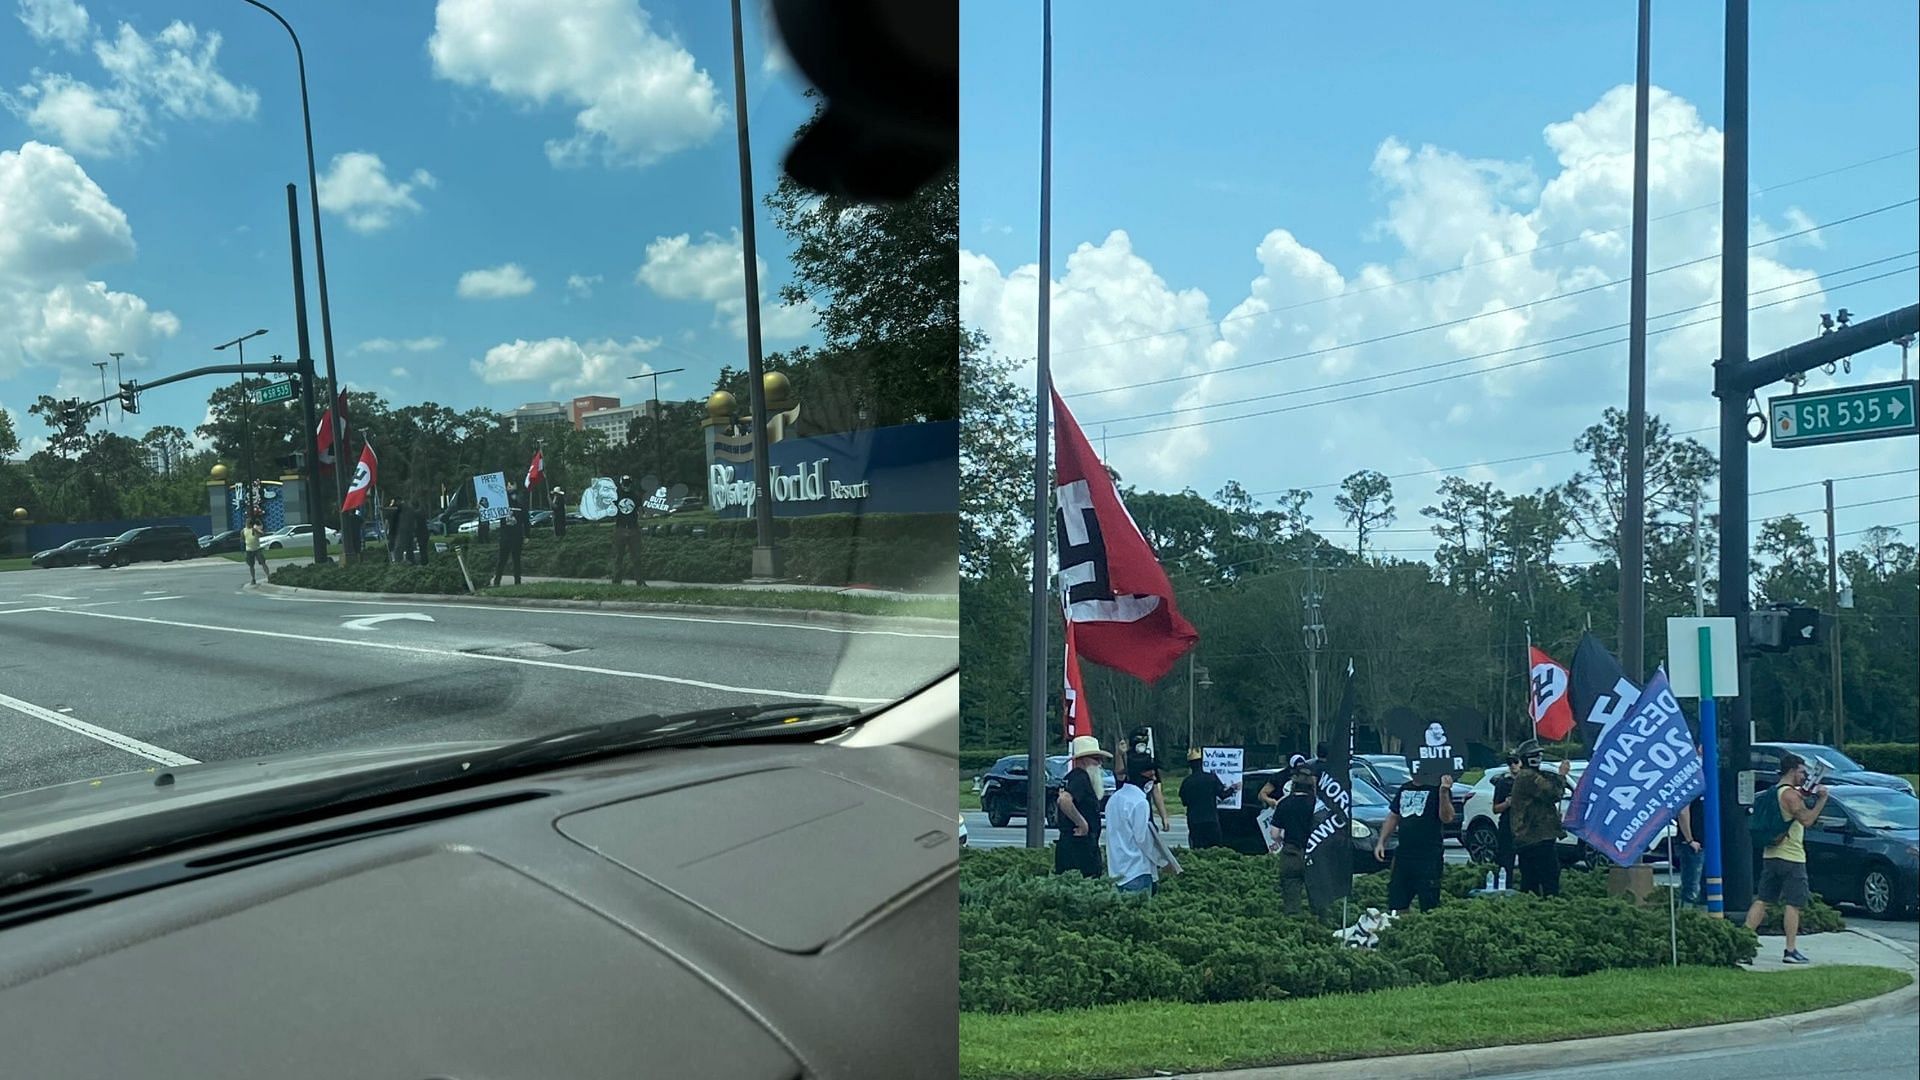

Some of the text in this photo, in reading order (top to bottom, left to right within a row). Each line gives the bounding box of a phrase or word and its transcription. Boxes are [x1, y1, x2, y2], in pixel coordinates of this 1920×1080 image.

[268, 384, 289, 399] SR 535
[1803, 398, 1881, 430] SR 535
[829, 480, 869, 499] Resort
[643, 500, 670, 511] FUCKER
[650, 495, 667, 505] BUTT
[1420, 745, 1452, 759] BUTT
